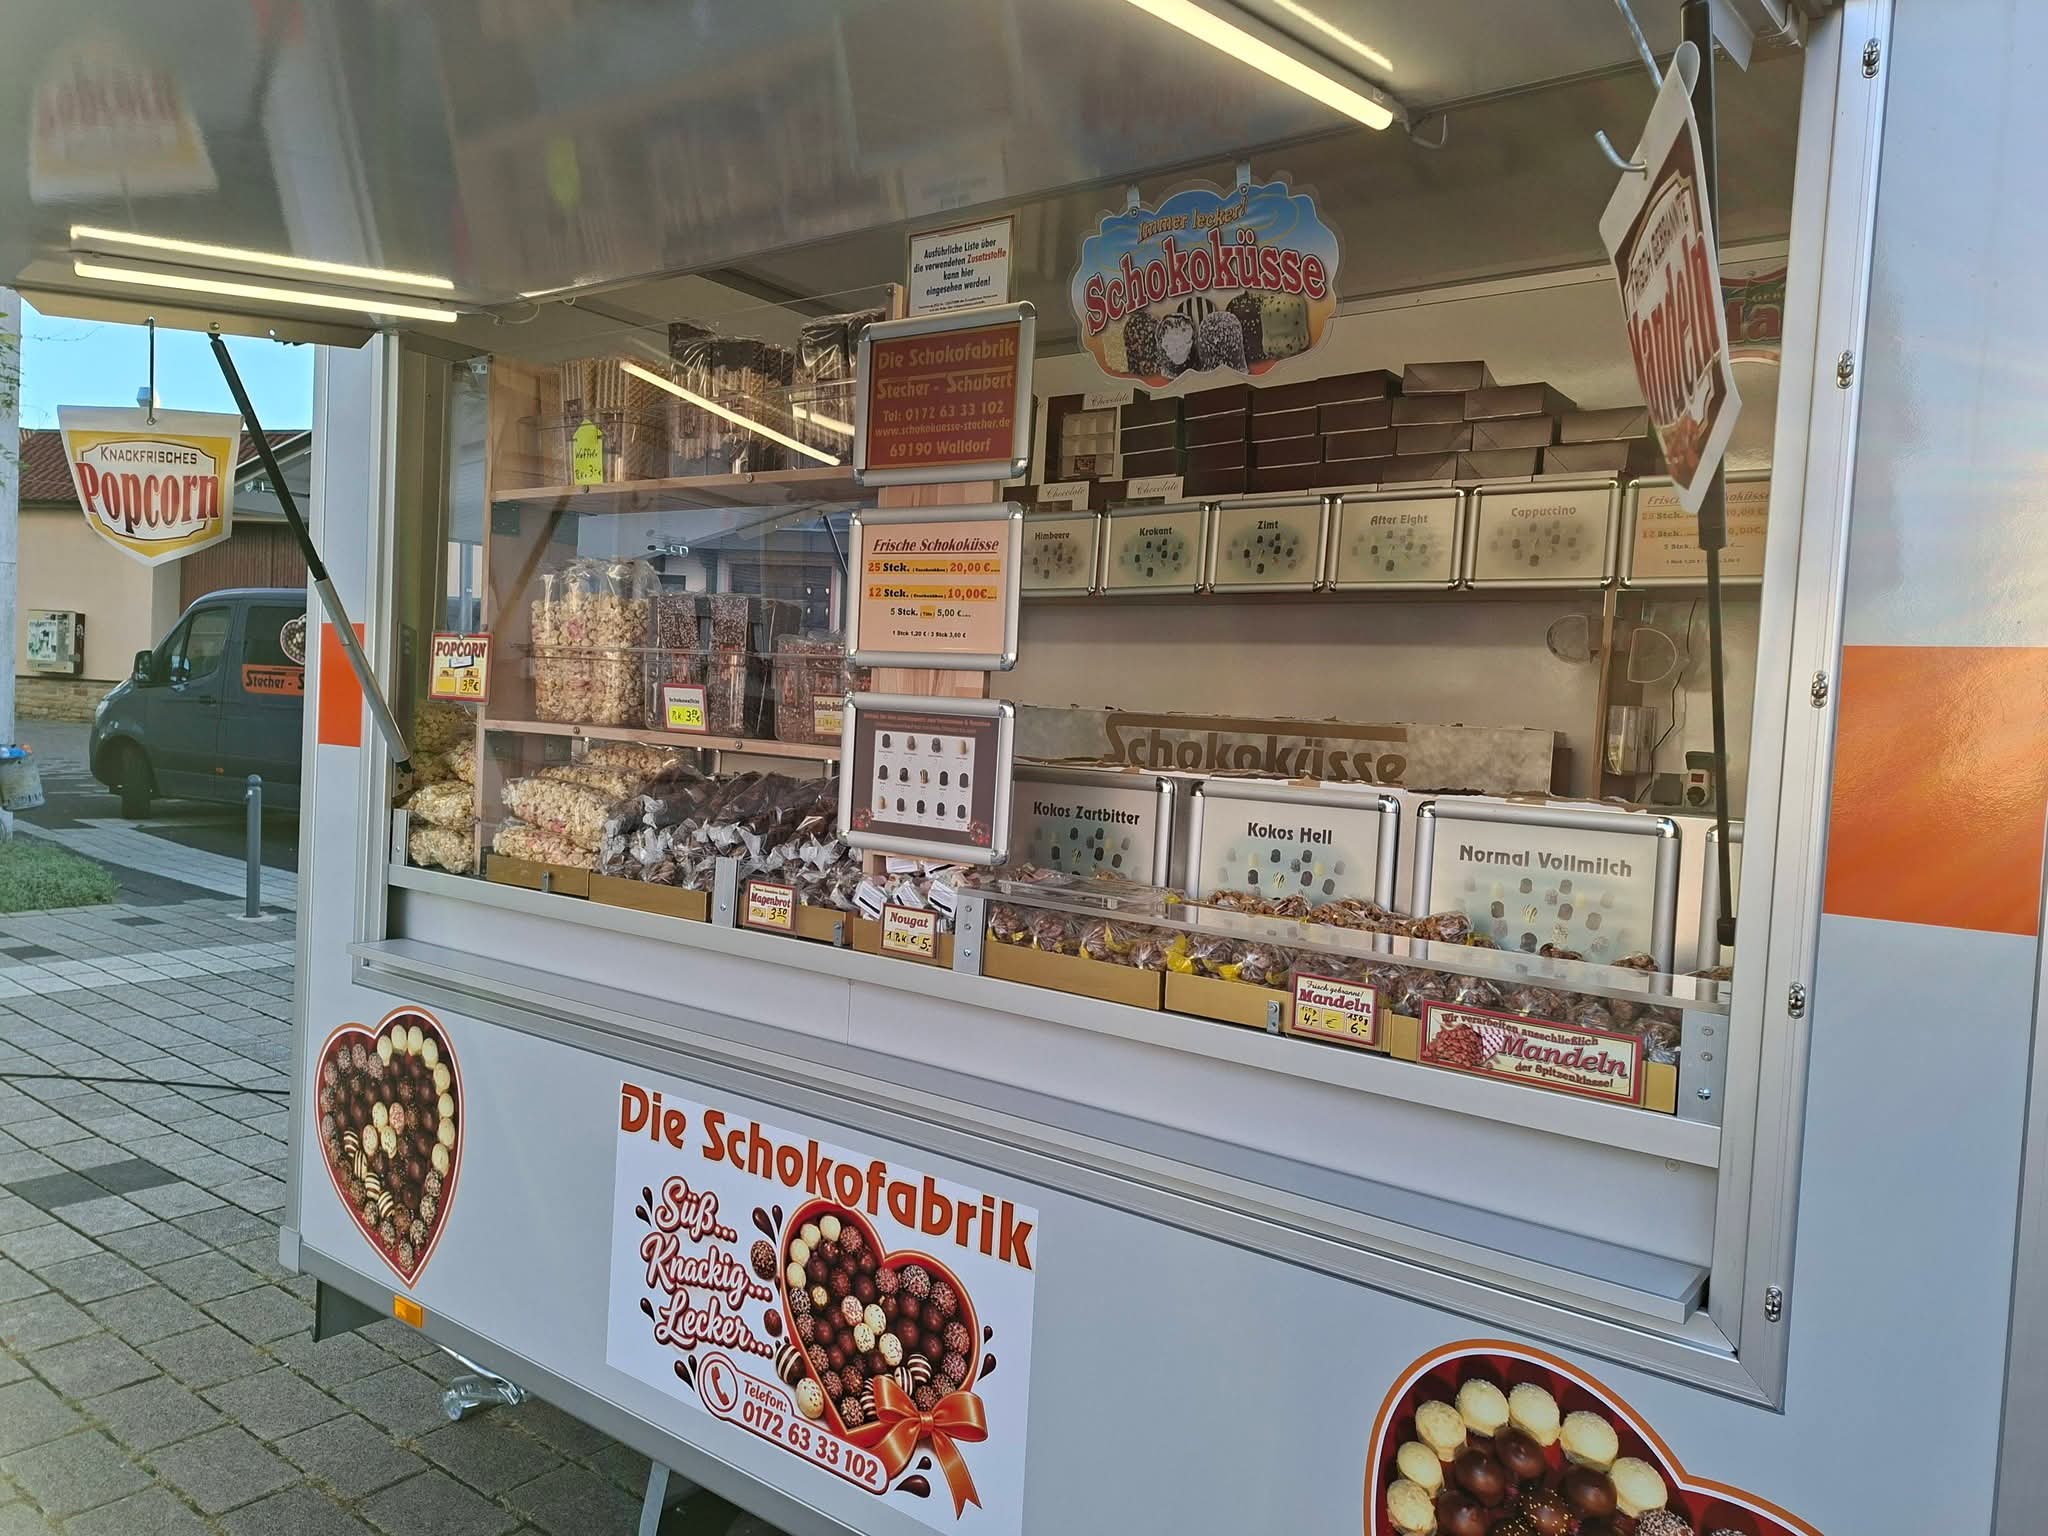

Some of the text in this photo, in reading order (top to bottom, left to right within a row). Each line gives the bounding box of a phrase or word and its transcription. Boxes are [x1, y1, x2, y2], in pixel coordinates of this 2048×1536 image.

[1137, 215, 1188, 244] Immer
[924, 237, 996, 259] Ausführliche Liste über
[914, 248, 1006, 273] die verwendeten Zusatzstoffe
[944, 268, 974, 280] kann hier
[1084, 228, 1326, 337] Schokoküsse
[926, 276, 991, 296] eingesehen werden!
[878, 338, 1014, 369] Die Schokofabrik
[877, 374, 936, 400] Stecher
[945, 366, 1014, 393] Schubert
[883, 401, 1004, 422] Tel: 0172 63 33 102
[890, 438, 992, 457] 69190 Walldorf
[75, 462, 220, 534] Popcorn
[1046, 486, 1086, 499] Chocolate
[1136, 480, 1180, 496] Chocolate
[1370, 514, 1429, 526] After Eight
[1511, 505, 1577, 520] Cappuccino
[1034, 531, 1070, 541] Himbeere
[1139, 527, 1172, 537] Krokant
[1257, 520, 1279, 530] Zimt
[872, 538, 999, 552] Frische Schokoküsse
[868, 562, 881, 573] 25
[883, 563, 910, 573] Stck.
[950, 562, 981, 575] 20,00
[869, 587, 882, 597] 12
[884, 588, 909, 598] Stck.
[890, 608, 896, 616] 5
[897, 608, 919, 616] Stck.
[937, 609, 955, 618] 5,00
[436, 641, 487, 658] POPCORN
[246, 670, 286, 689] Stecher
[1104, 713, 1407, 784] Schokoküsse
[1033, 801, 1140, 826] Kokos Zartbitter
[1248, 822, 1332, 845] Kokos Hell
[1459, 845, 1632, 877] Normal Vollmilch
[751, 892, 791, 908] Magenbrot
[890, 912, 929, 928] Nougat
[1306, 981, 1329, 992] Frisch
[1298, 988, 1372, 1014] Mandeln
[1441, 1013, 1599, 1047] Wir verarbeiten ausschließlich
[1499, 1036, 1628, 1079] Mandeln
[1515, 1062, 1614, 1088] der Spitzenklasse!
[621, 1082, 1033, 1270] Die Schokofabrik
[655, 1176, 738, 1243] Süß...
[640, 1231, 773, 1310] Knackig...
[654, 1287, 774, 1360] Lecker...
[744, 1380, 787, 1413] Telefon:
[743, 1400, 878, 1486] 0172 63 33 102
